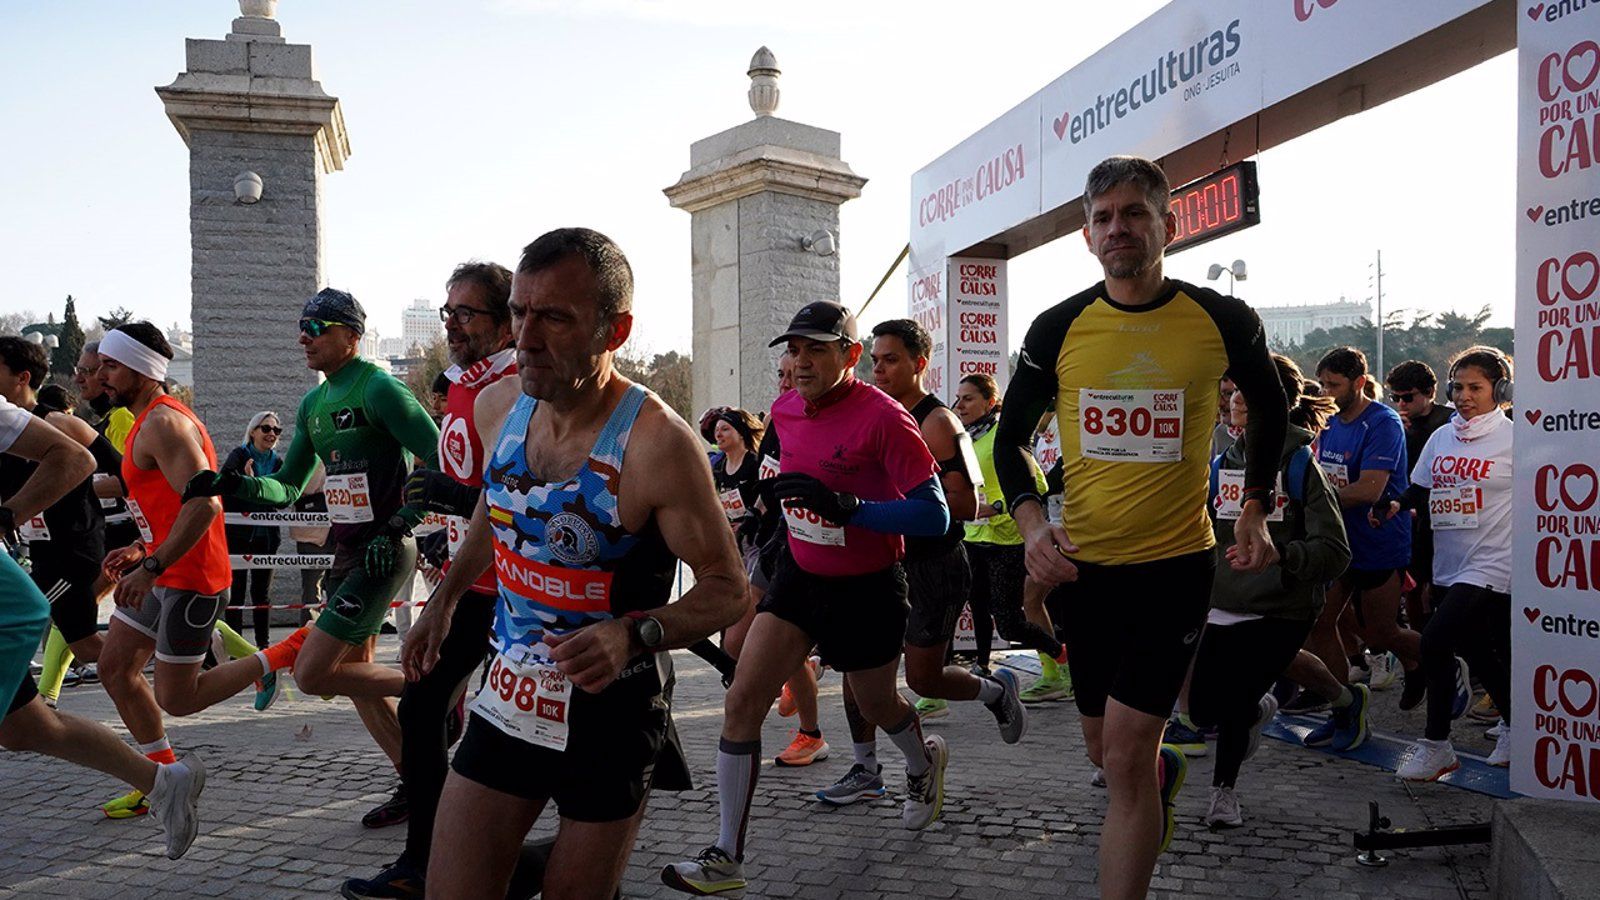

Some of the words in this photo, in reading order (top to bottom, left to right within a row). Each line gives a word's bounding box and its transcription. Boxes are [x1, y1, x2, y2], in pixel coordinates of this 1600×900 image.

[1070, 19, 1241, 145] entreculturas
[1183, 82, 1201, 102] ONG
[1205, 62, 1241, 91] JESUITA
[1540, 99, 1574, 126] POR
[1576, 89, 1600, 115] UN
[976, 143, 1025, 201] CAUSA
[920, 178, 961, 228] CORRE
[960, 264, 998, 280] CORRE
[960, 281, 997, 296] CAUSA
[960, 312, 998, 328] CORRE
[1538, 307, 1572, 329] POR
[960, 329, 997, 344] CAUSA
[960, 361, 998, 376] CORRE
[1083, 406, 1152, 437] 830
[1158, 422, 1175, 434] 10K
[1542, 409, 1600, 432] entre
[1432, 455, 1496, 482] CORRE
[250, 512, 330, 522] entreculturas
[1430, 499, 1461, 515] 2395
[1537, 515, 1571, 537] POR
[253, 556, 331, 566] entreculturas
[1541, 613, 1600, 639] entre
[489, 658, 537, 711] 898
[1533, 664, 1600, 718] CO
[541, 702, 559, 719] 10K
[1535, 713, 1570, 741] POR
